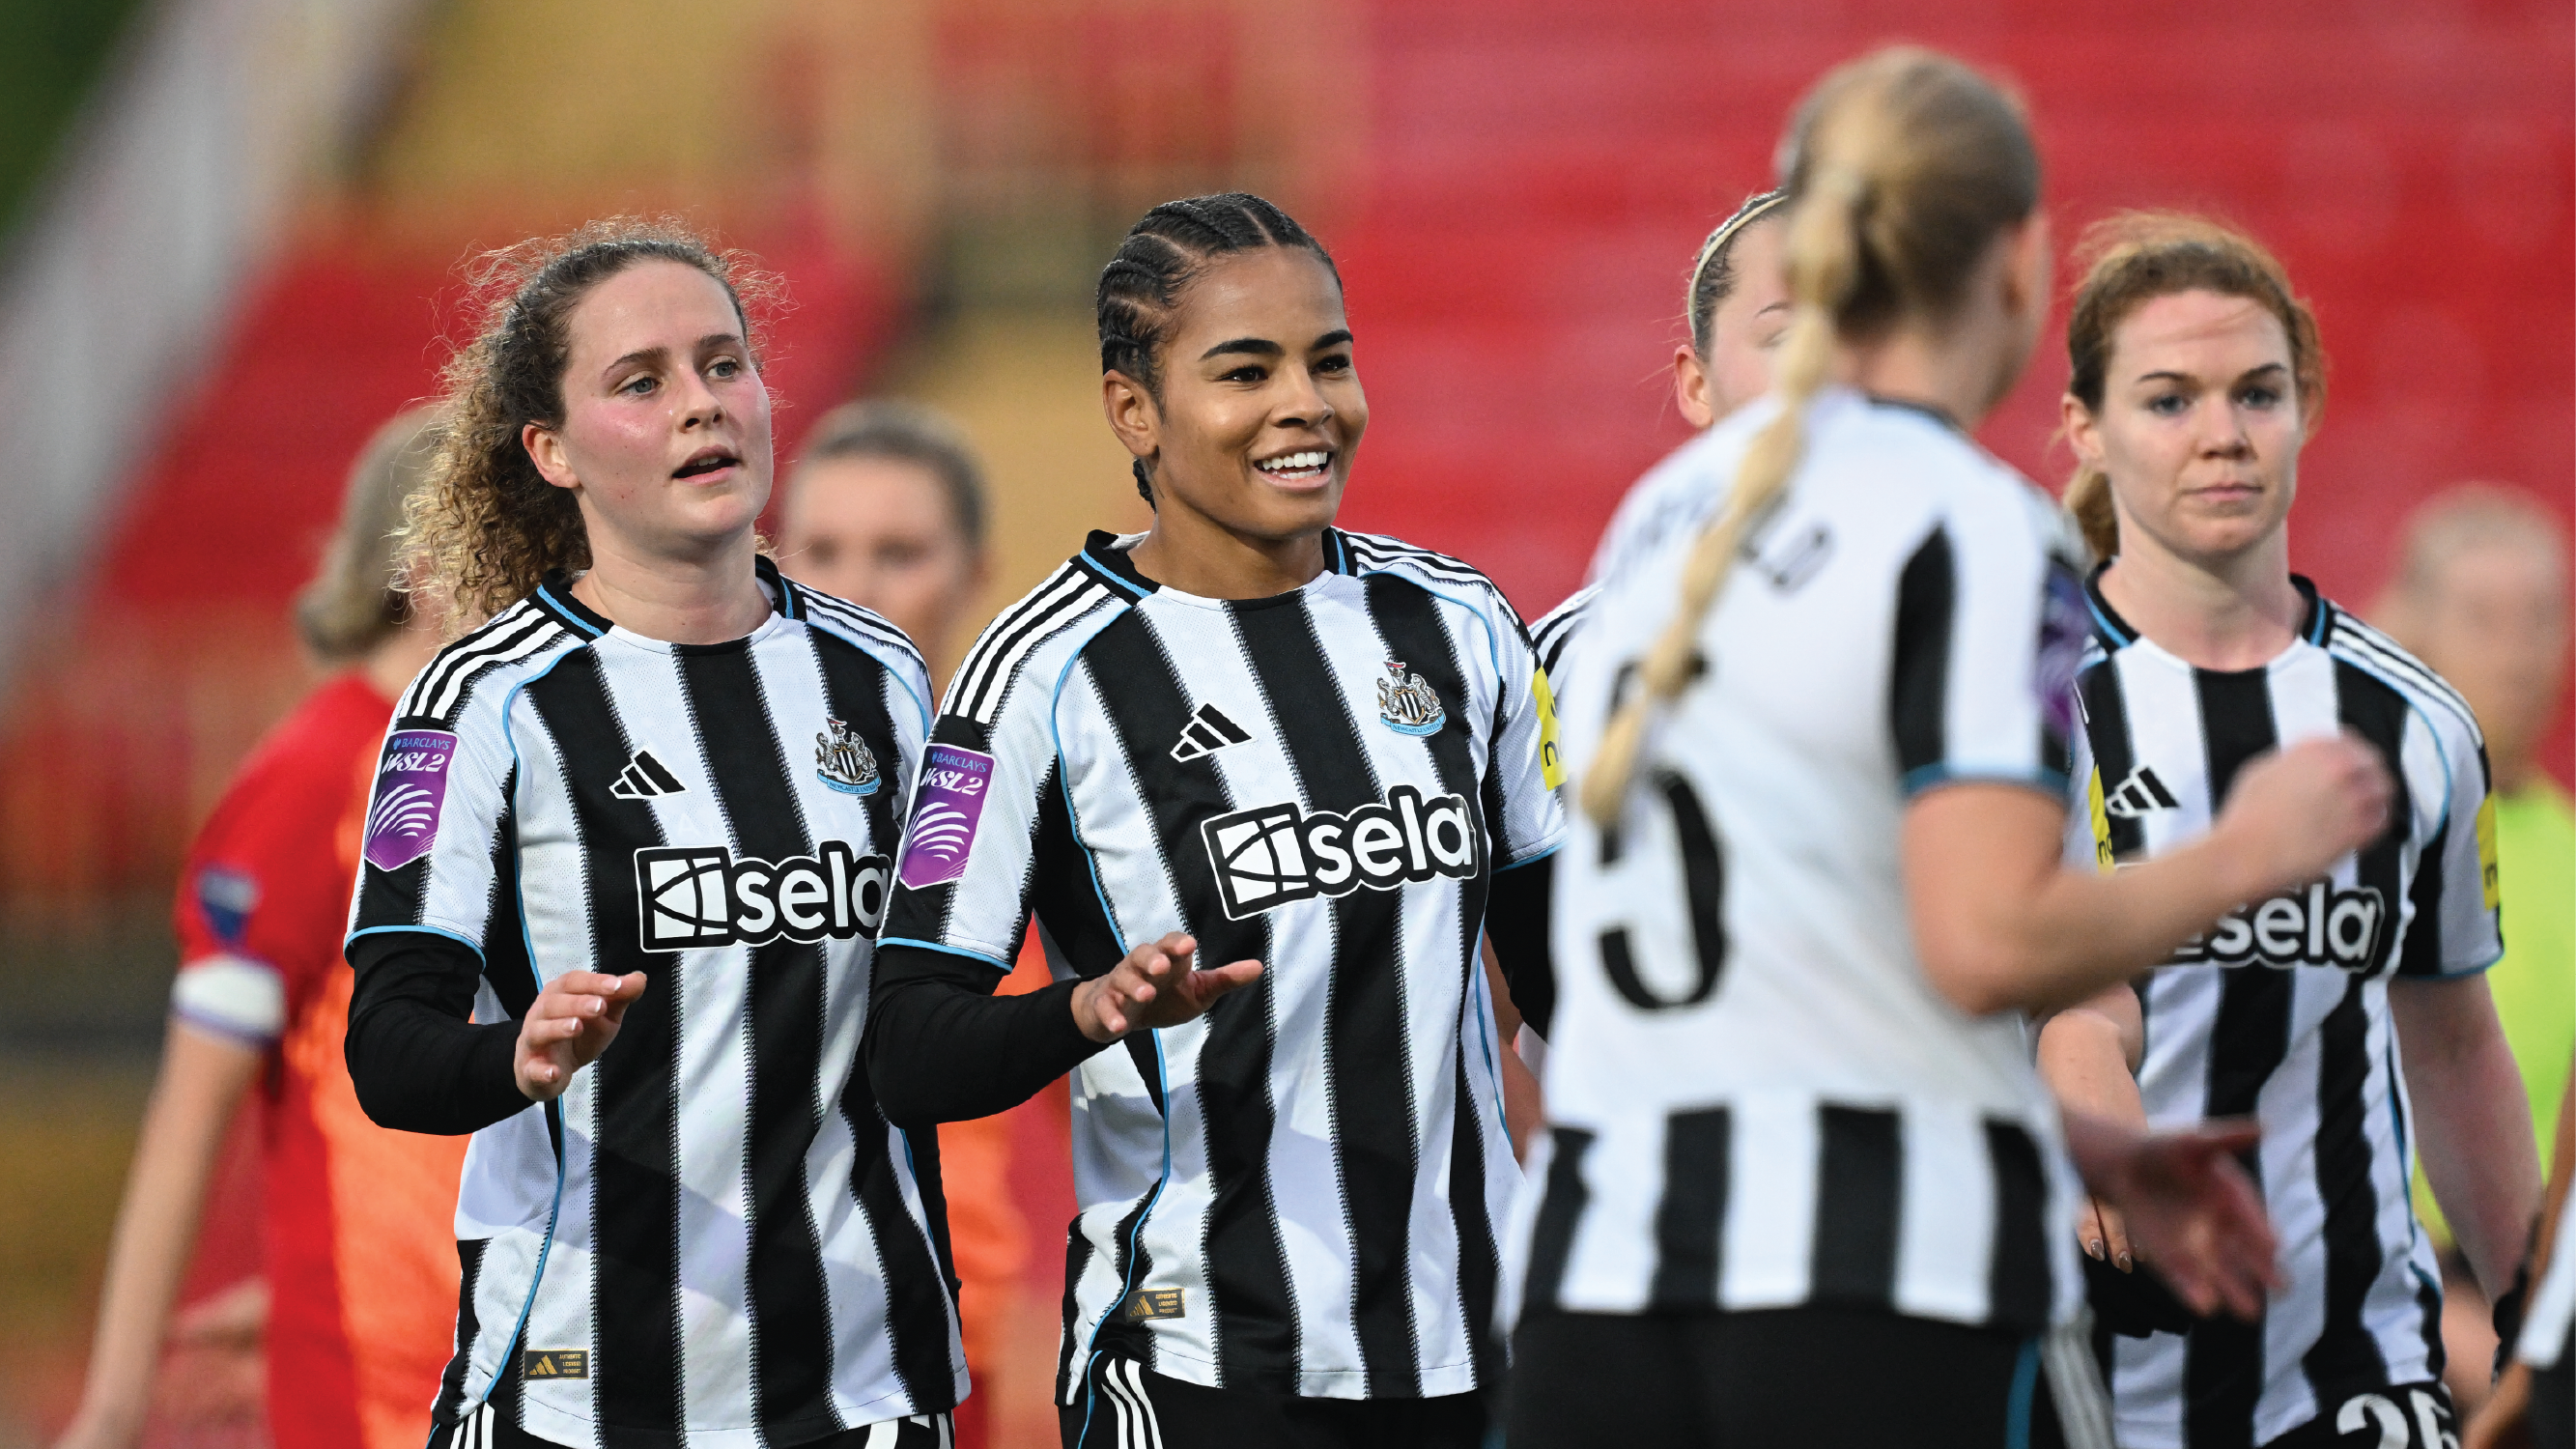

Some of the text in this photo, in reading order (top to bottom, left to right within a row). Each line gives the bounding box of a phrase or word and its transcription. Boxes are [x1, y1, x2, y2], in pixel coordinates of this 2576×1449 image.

[401, 737, 451, 751] BARCLAYS
[936, 753, 987, 773] BARCLAYS
[1308, 795, 1472, 884] sela
[735, 850, 889, 933] sela
[2210, 883, 2377, 961] sela
